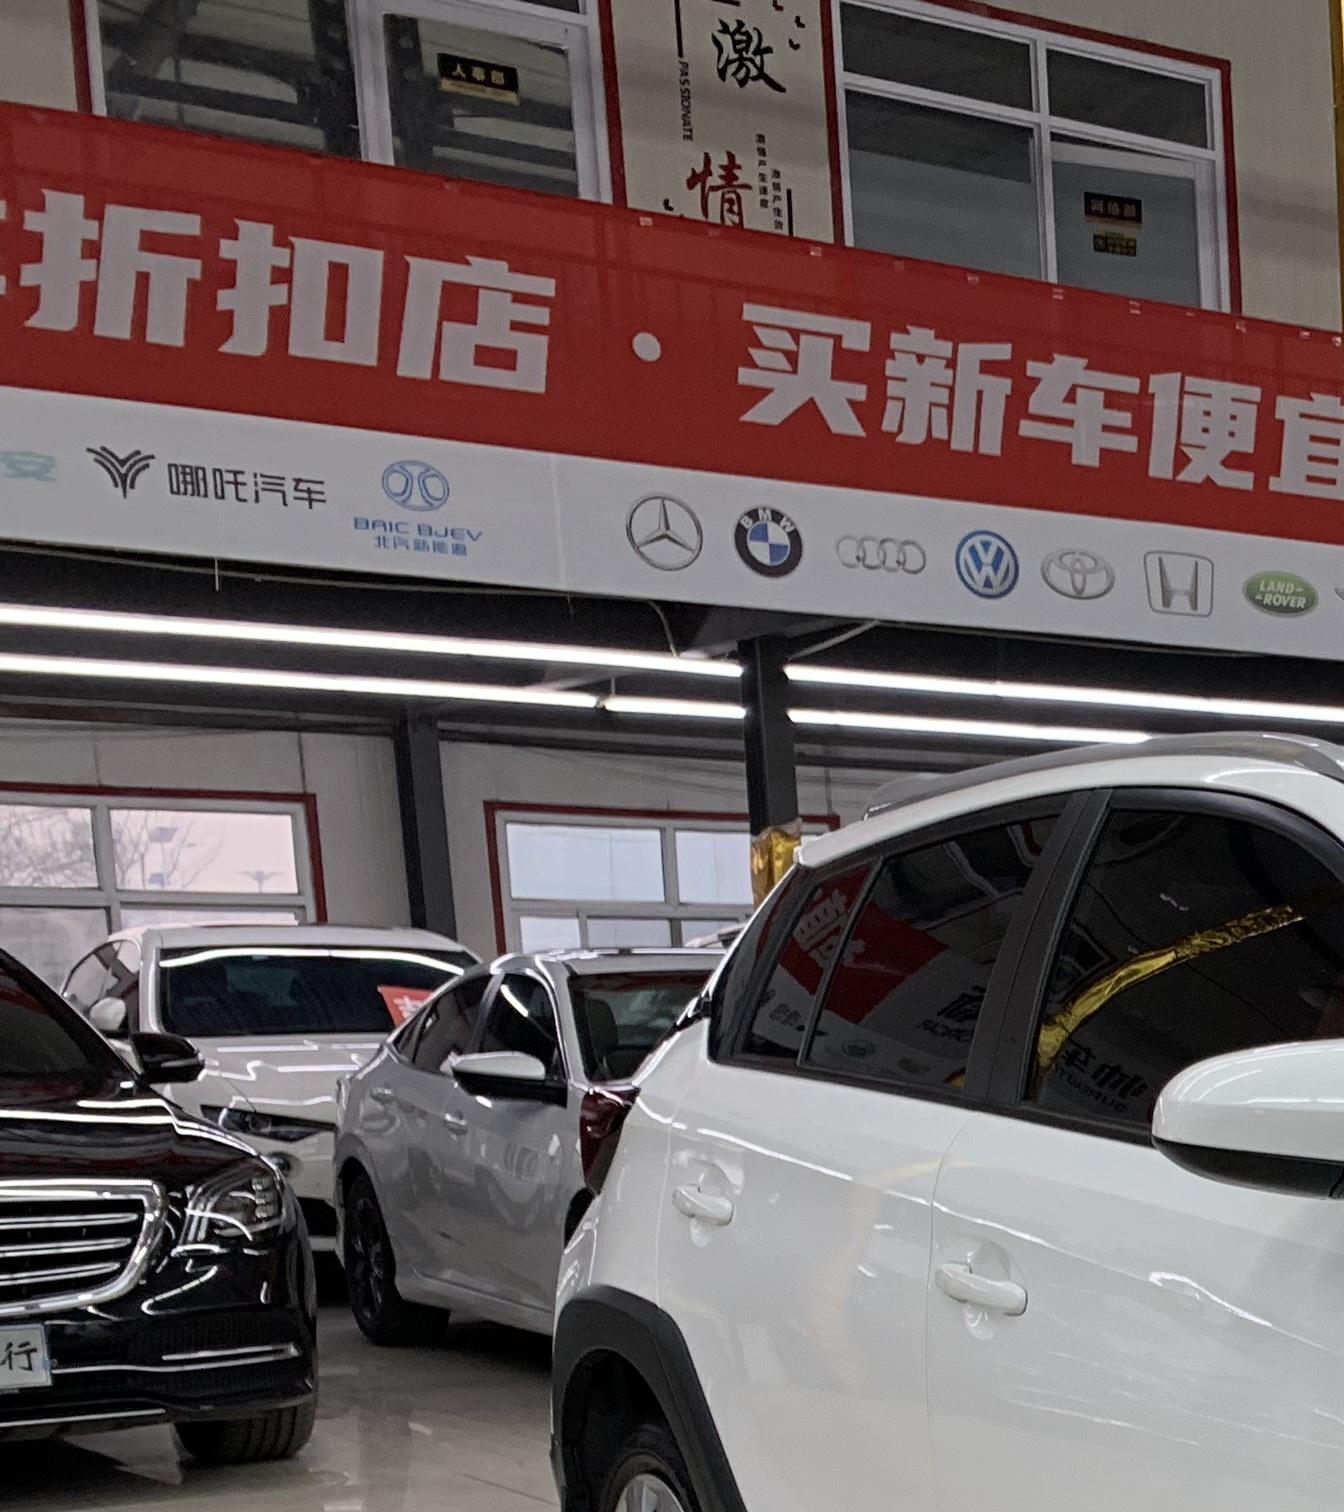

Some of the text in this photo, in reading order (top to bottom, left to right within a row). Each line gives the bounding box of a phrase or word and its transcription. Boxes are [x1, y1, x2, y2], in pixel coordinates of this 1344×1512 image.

[677, 60, 694, 142] PASSIONATE
[0, 189, 557, 393] 折扣店
[167, 462, 327, 510] 哪吒汽车
[353, 517, 483, 543] BAIC BJEV
[373, 536, 468, 556] 北汽新能源
[0, 1341, 38, 1372] 行
